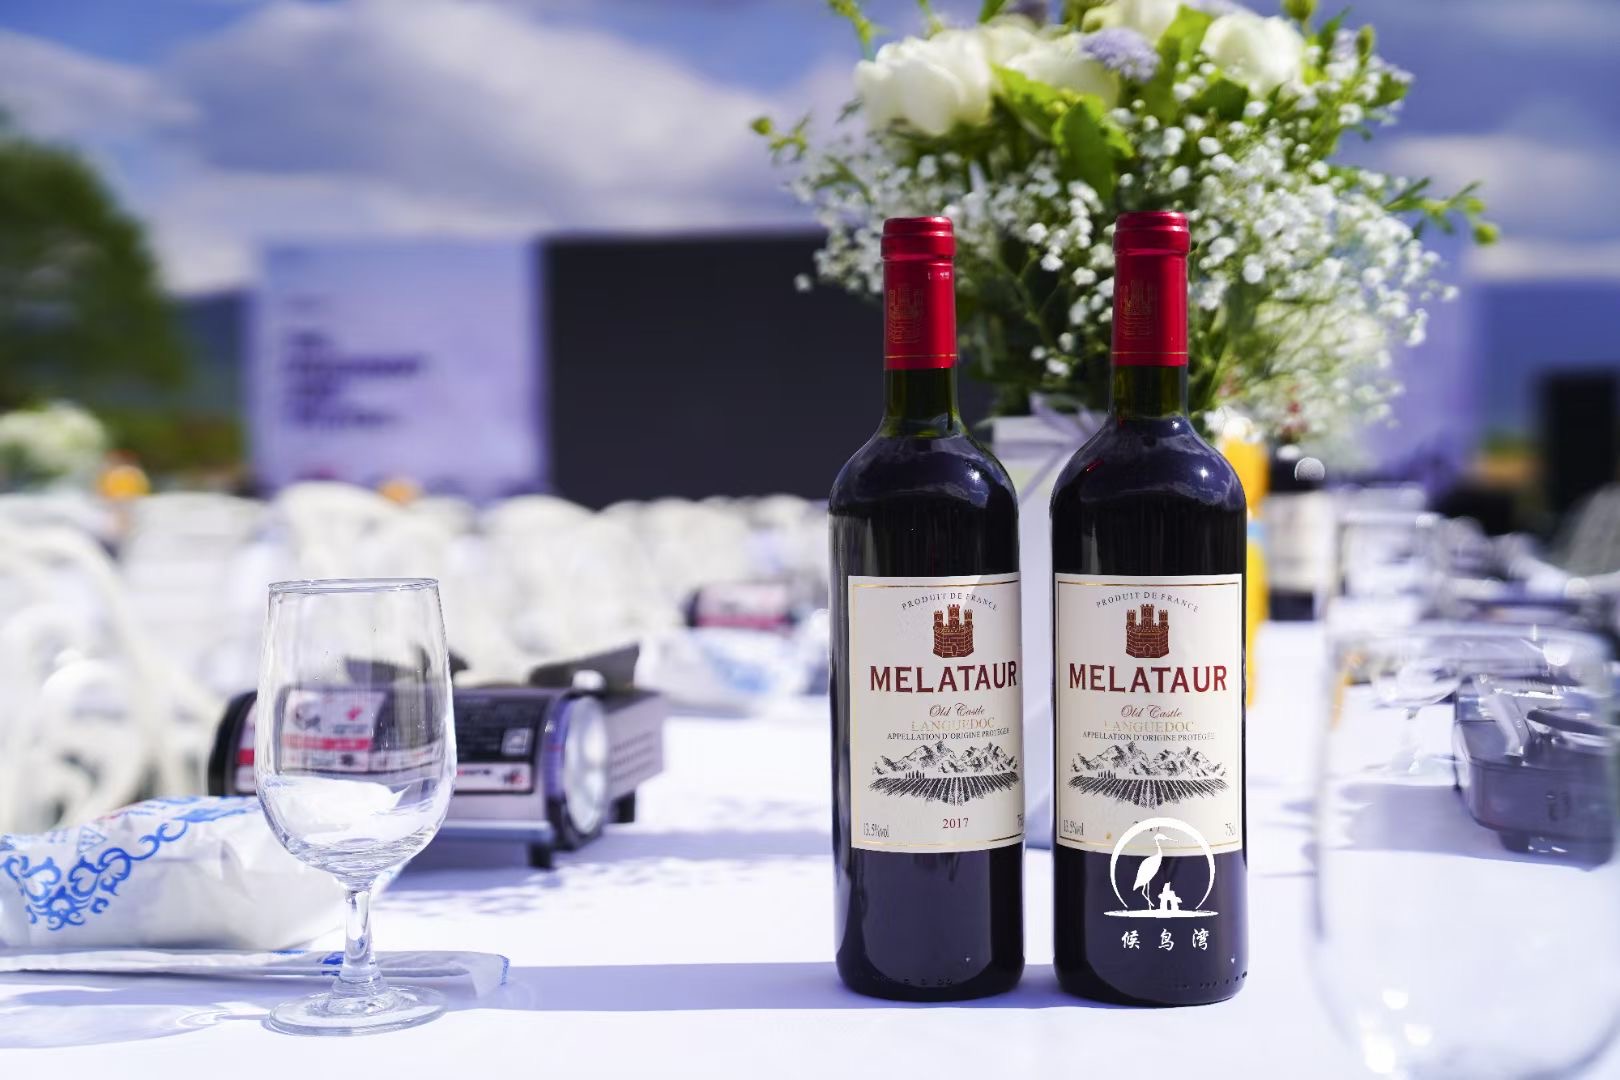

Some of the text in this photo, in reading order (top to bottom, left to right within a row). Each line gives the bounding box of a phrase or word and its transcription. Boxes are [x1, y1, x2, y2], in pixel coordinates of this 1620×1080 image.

[901, 592, 998, 611] PRODUIT DE FRANCE
[1096, 592, 1199, 613] PRODUIT DE FRANCE
[870, 660, 1017, 693] MELATAUR
[1069, 663, 1227, 694] MELATAUR
[929, 702, 985, 718] Old Castle
[1120, 703, 1183, 719] Old Castle
[887, 732, 940, 741] APPELLATION
[1082, 731, 1132, 741] APPELLATION
[942, 817, 969, 829] 2017
